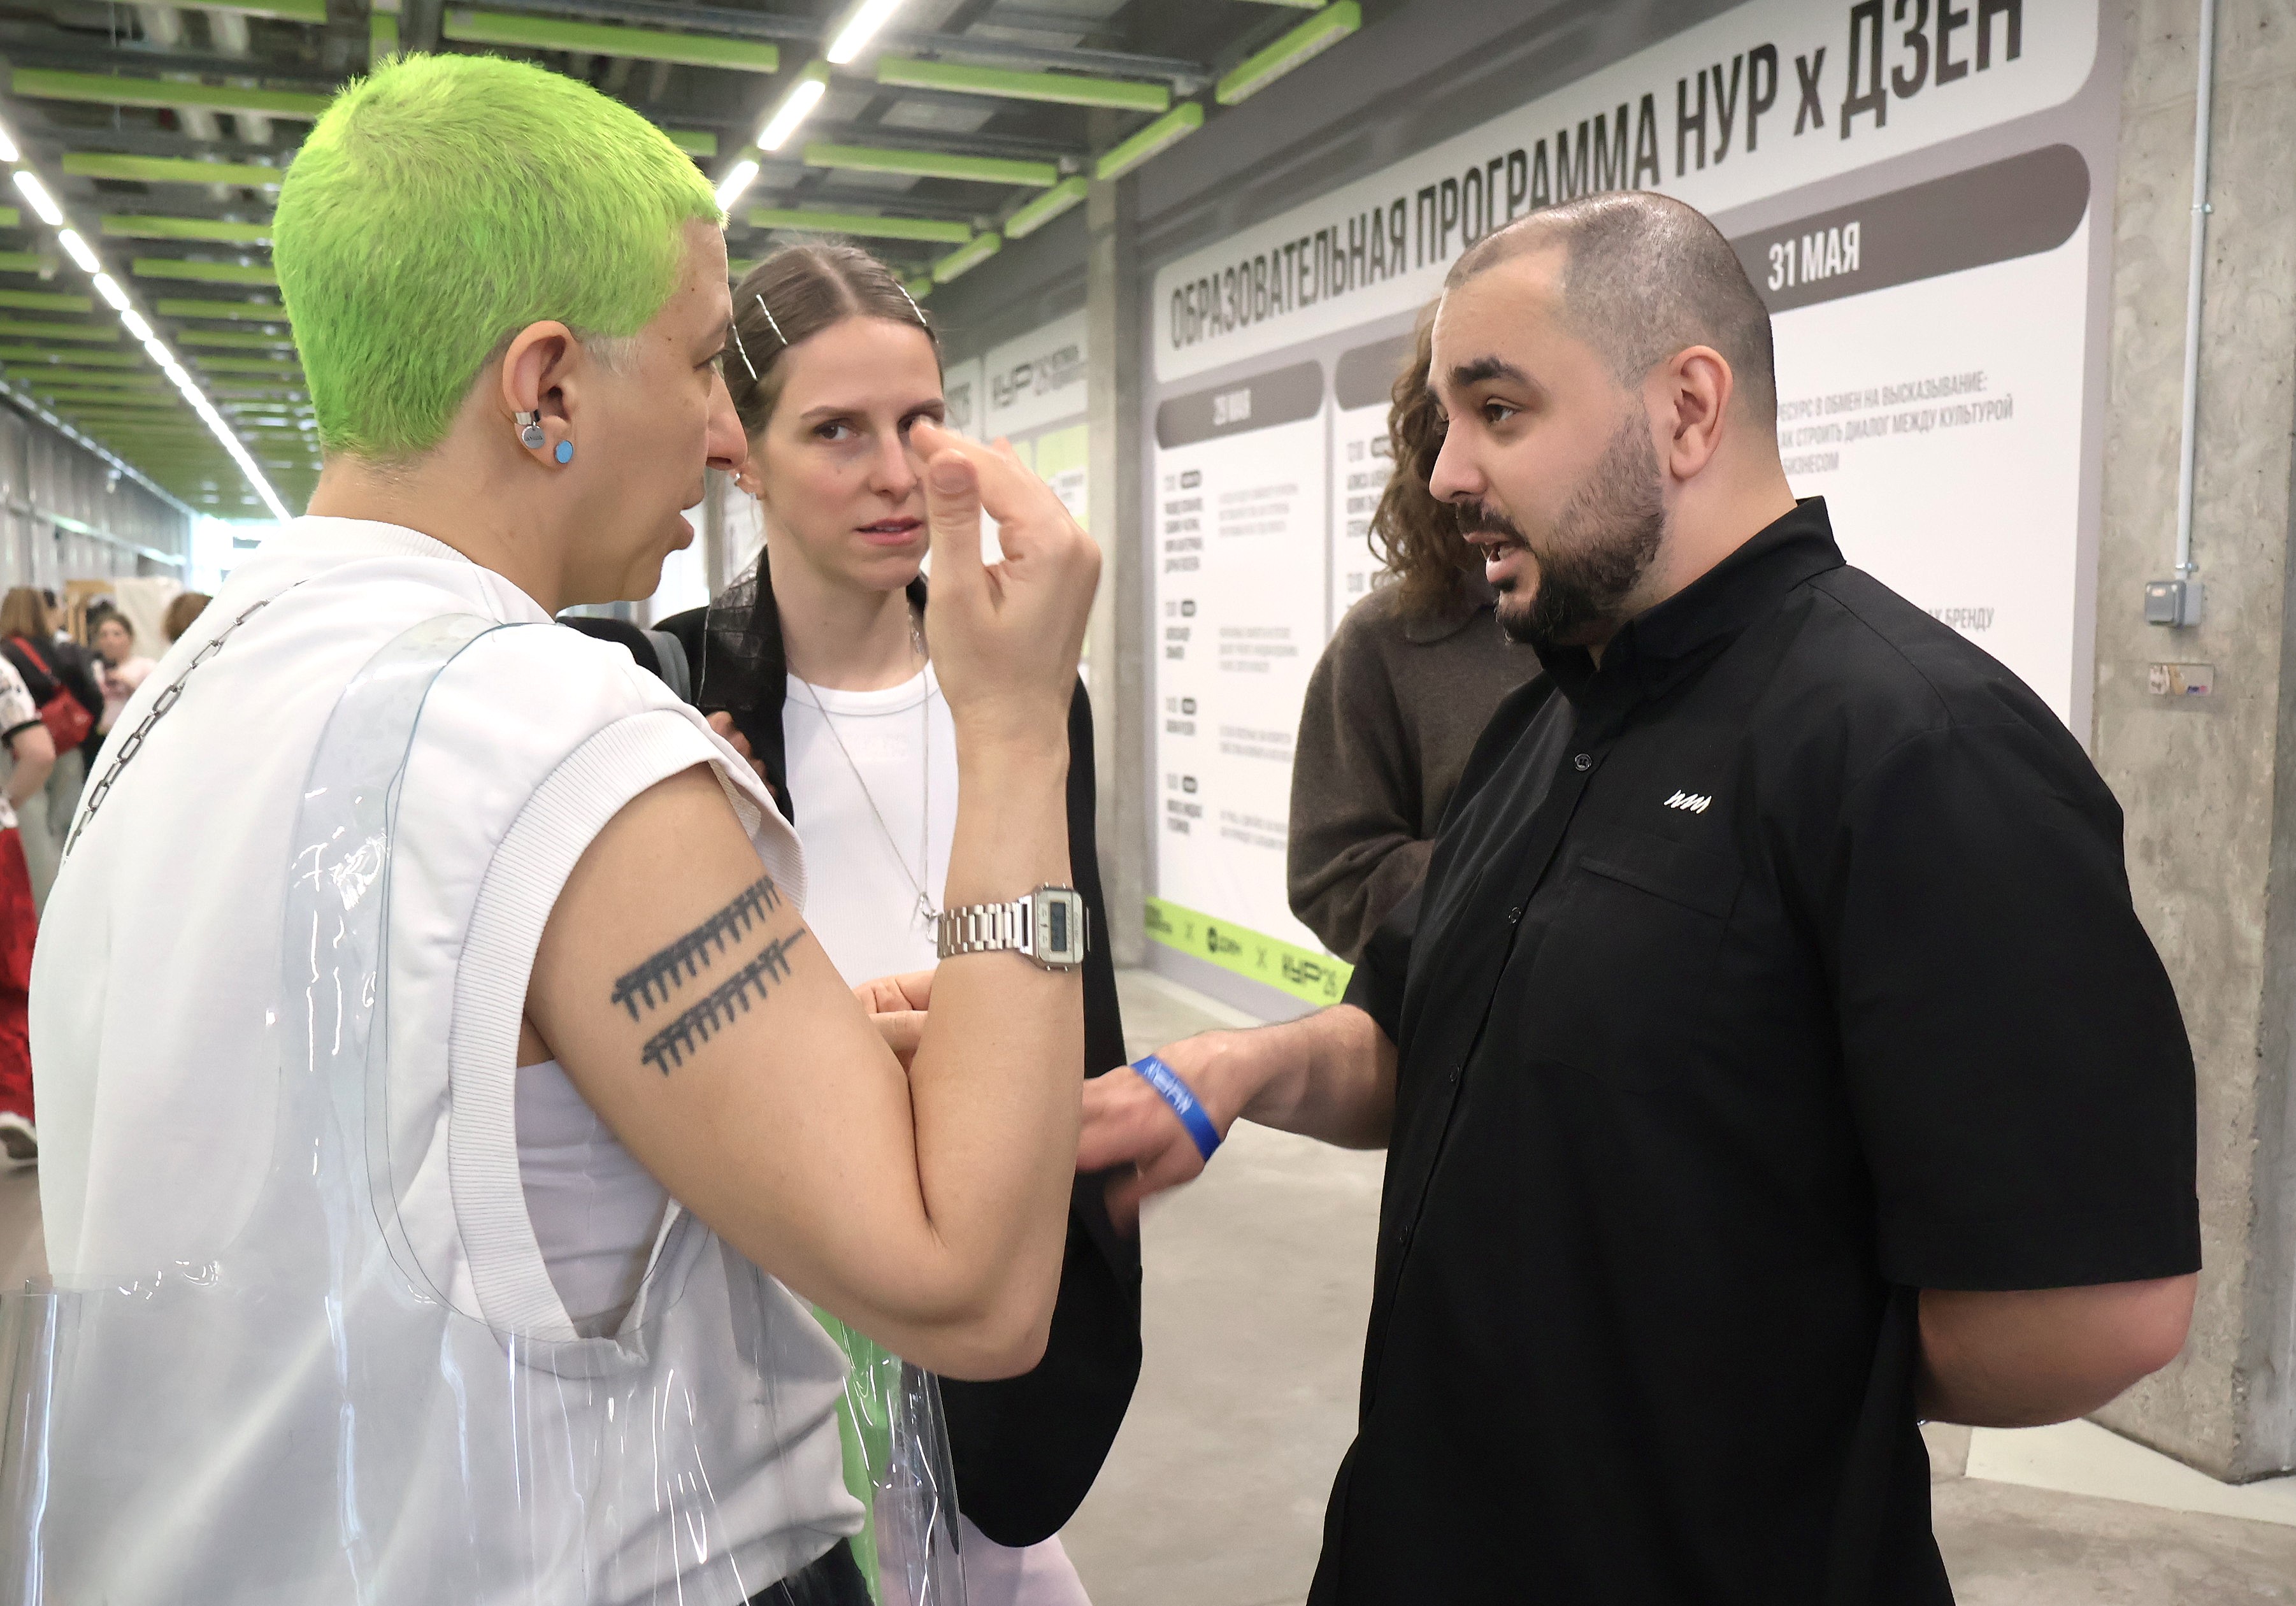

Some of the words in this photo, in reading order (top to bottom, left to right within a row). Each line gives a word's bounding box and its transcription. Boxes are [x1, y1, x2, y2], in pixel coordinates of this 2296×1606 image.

[1170, 196, 1407, 351] ОБРАЗОВАТЕЛЬНАЯ
[1416, 92, 1661, 269] ПРОГРАММА
[1676, 42, 1777, 178] НУР
[1840, 0, 2022, 141] ДЗЕН
[1768, 240, 1796, 291] 31
[1801, 222, 1861, 283] МАЯ
[1778, 429, 1795, 448] АК
[1939, 393, 2013, 428] КУЛЬТУРОЙ
[1945, 607, 1994, 632] БРЕНДУ
